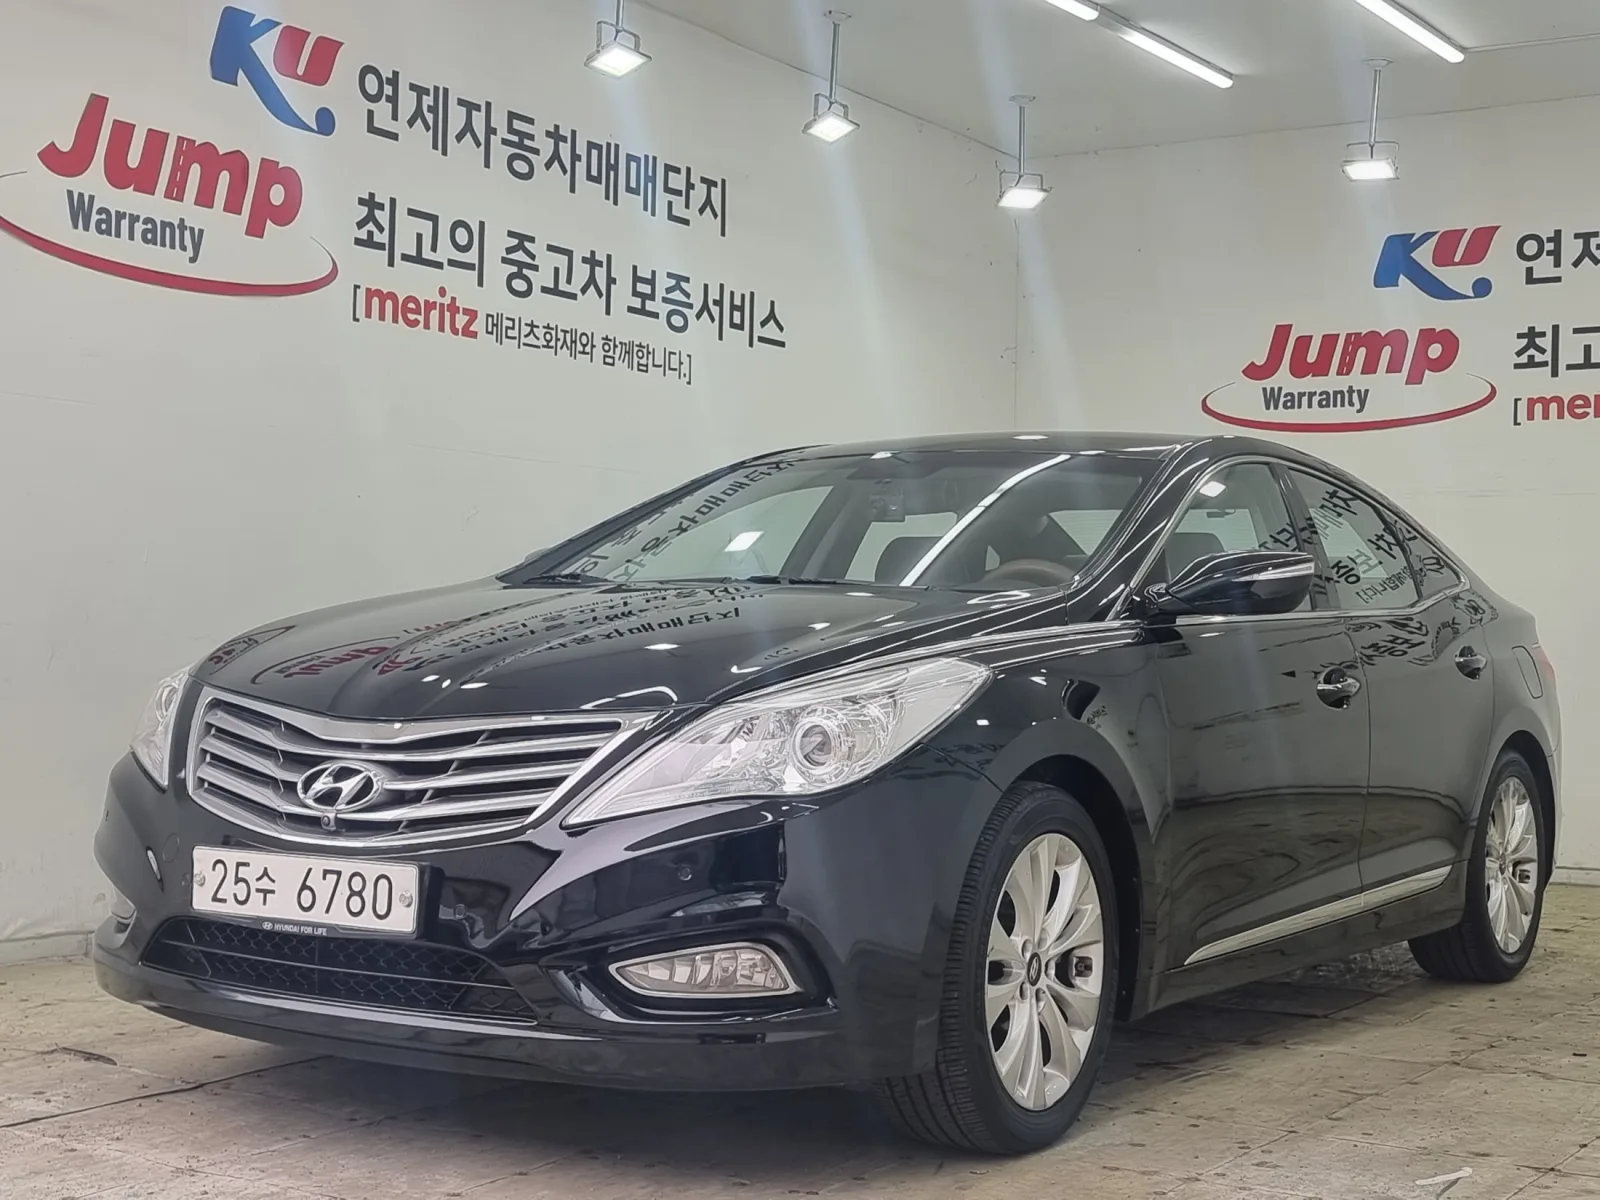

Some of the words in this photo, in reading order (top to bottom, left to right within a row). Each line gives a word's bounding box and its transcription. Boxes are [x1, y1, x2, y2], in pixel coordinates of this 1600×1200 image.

[37, 93, 303, 239] Jump
[357, 64, 728, 238] 연제자동차매매단지
[66, 189, 205, 264] Warranty
[353, 191, 486, 288] 최고의
[500, 229, 617, 317] 중고차
[626, 264, 787, 350] 보증서비스
[485, 312, 597, 363] 메리츠화재와
[1241, 323, 1460, 386] Jump
[1261, 386, 1370, 414] Warranty
[211, 858, 276, 906] 25수
[296, 867, 393, 920] 6780
[274, 923, 300, 933] HYUNDAI
[300, 925, 313, 934] FOR
[313, 926, 328, 936] LIFE
